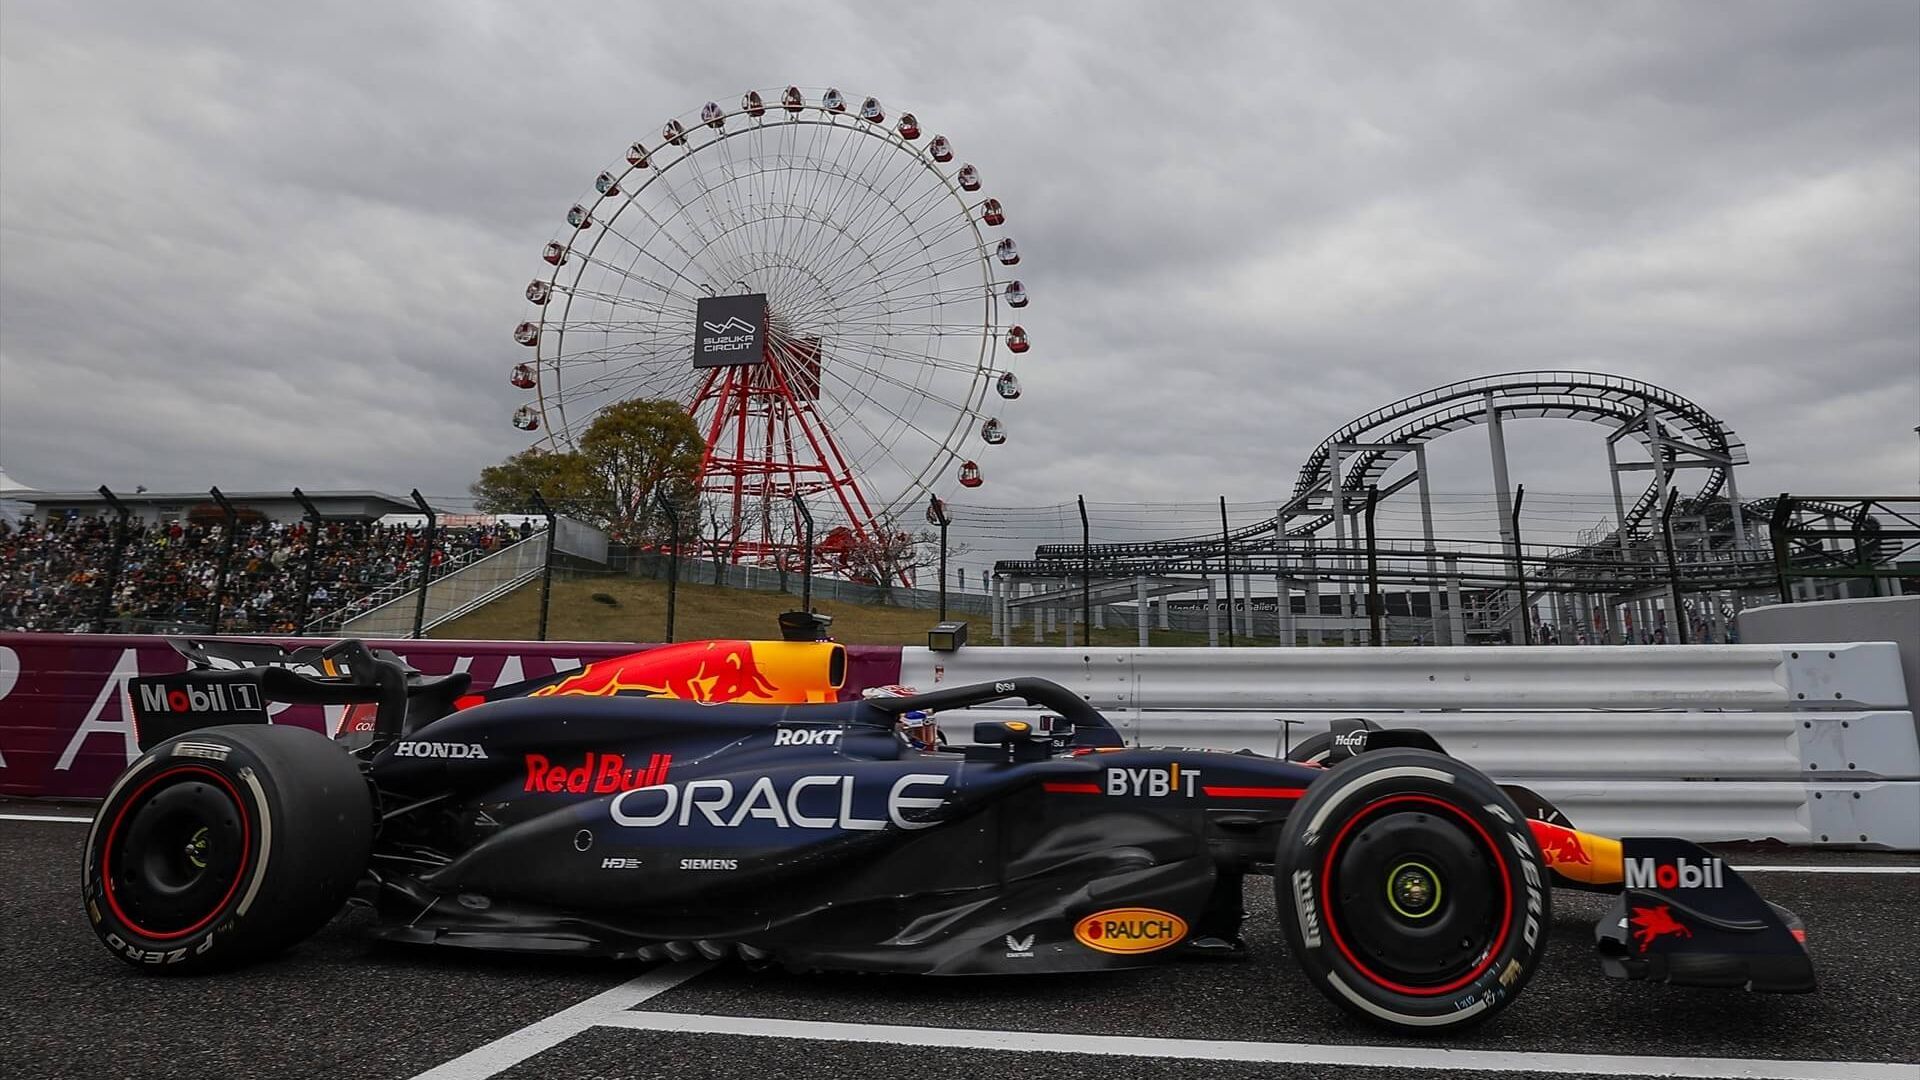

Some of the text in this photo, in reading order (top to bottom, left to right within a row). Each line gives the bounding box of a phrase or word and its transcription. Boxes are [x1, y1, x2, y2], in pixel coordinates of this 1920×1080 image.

[704, 335, 754, 345] SUZUKA
[704, 342, 752, 352] CIRCUIT
[140, 683, 252, 713] Mobil 1
[773, 728, 843, 746] ROKT
[1335, 734, 1362, 746] Hard
[394, 741, 489, 759] HONDA
[524, 752, 673, 794] Red Bull
[1107, 762, 1201, 798] BYBIT
[610, 774, 950, 830] ORACLE
[680, 858, 738, 870] SIEMENS
[1624, 857, 1724, 889] Mobil
[1483, 803, 1516, 825] P
[1507, 831, 1543, 951] ZERO
[1105, 920, 1173, 940] RAUCH
[105, 932, 188, 964] ZERO
